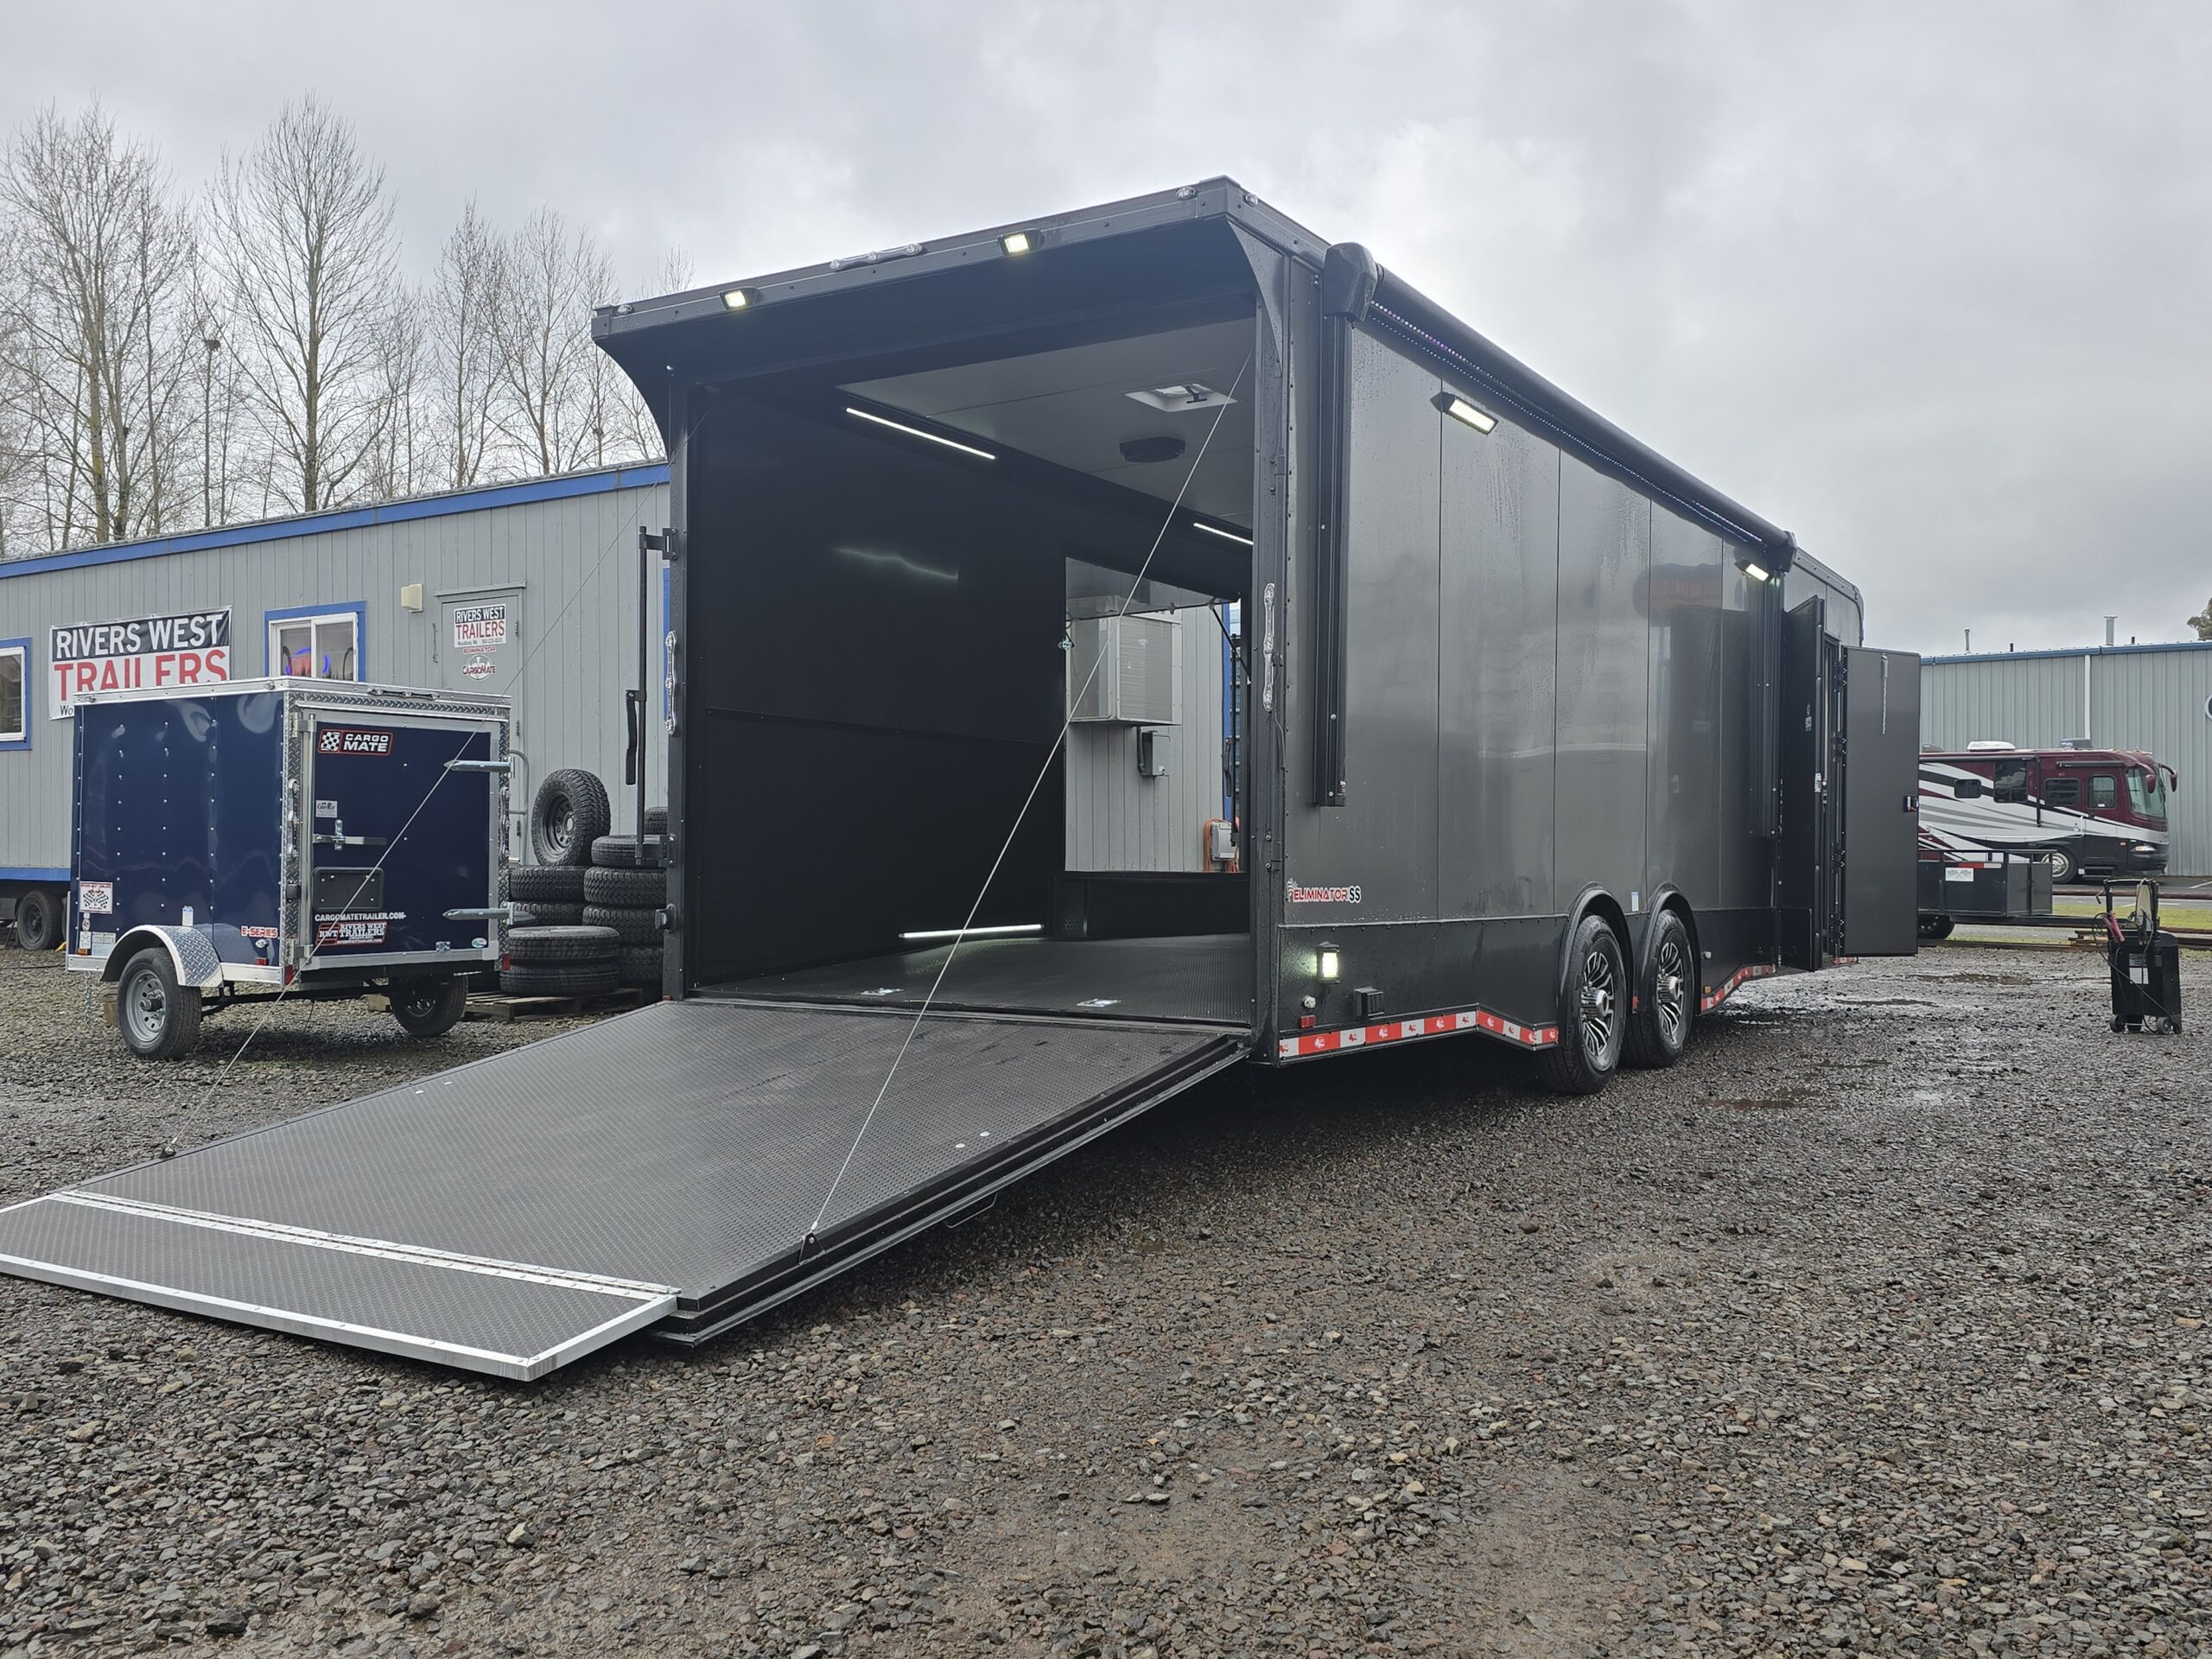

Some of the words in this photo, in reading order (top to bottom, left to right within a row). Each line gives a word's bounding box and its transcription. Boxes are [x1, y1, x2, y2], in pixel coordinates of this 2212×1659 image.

[456, 608, 482, 623] RIVERS
[483, 607, 504, 620] WEST
[56, 622, 142, 659] RIVERS
[148, 614, 223, 651] WEST
[455, 620, 505, 640] TRAILERS
[54, 649, 227, 702] TRAILERS
[346, 734, 389, 742] CARGO
[343, 741, 388, 752] MATE
[1294, 887, 1348, 901] ELIMINATOR
[1349, 886, 1361, 903] SS
[241, 926, 277, 938] E-SERIES
[340, 928, 385, 938] TRAILERS
